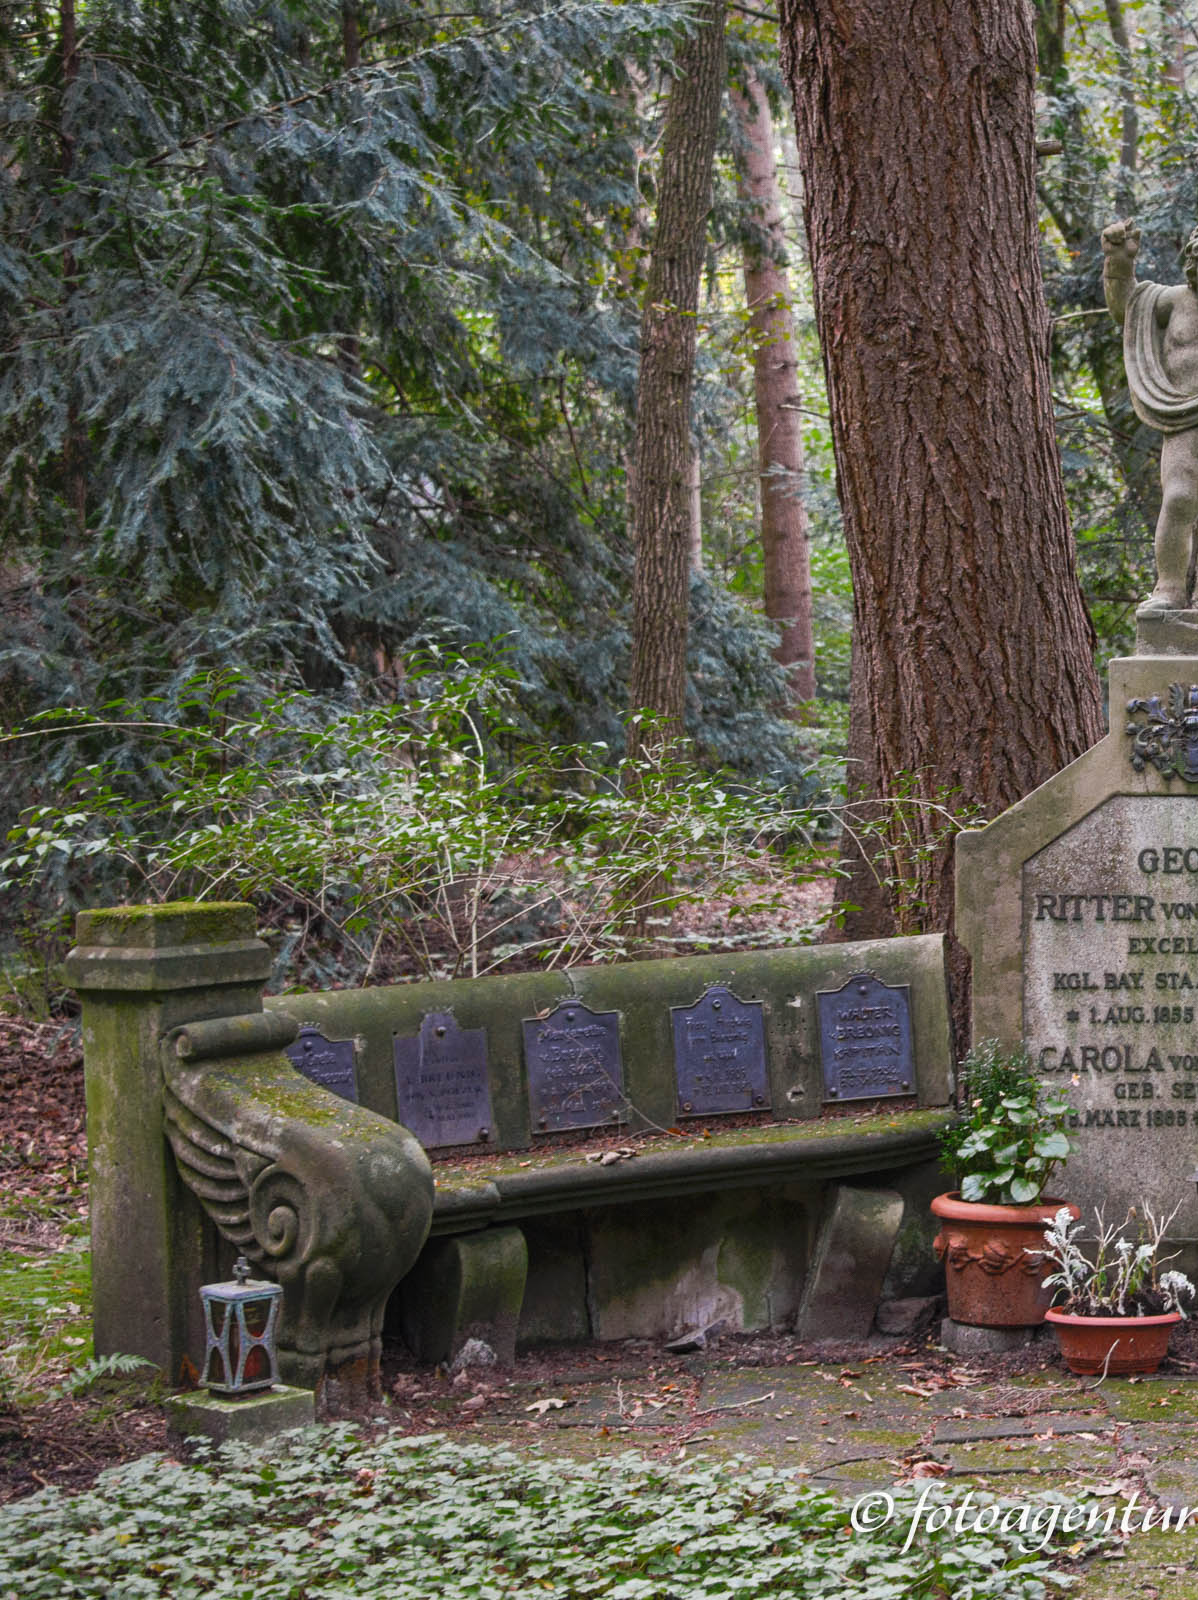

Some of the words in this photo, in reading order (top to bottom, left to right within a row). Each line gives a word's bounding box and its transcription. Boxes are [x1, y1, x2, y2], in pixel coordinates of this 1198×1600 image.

[1035, 894, 1155, 922] RITTER
[838, 1005, 894, 1022] WALTER
[1039, 1046, 1164, 1073] CAROLA
[1114, 1083, 1161, 1100] GEB.
